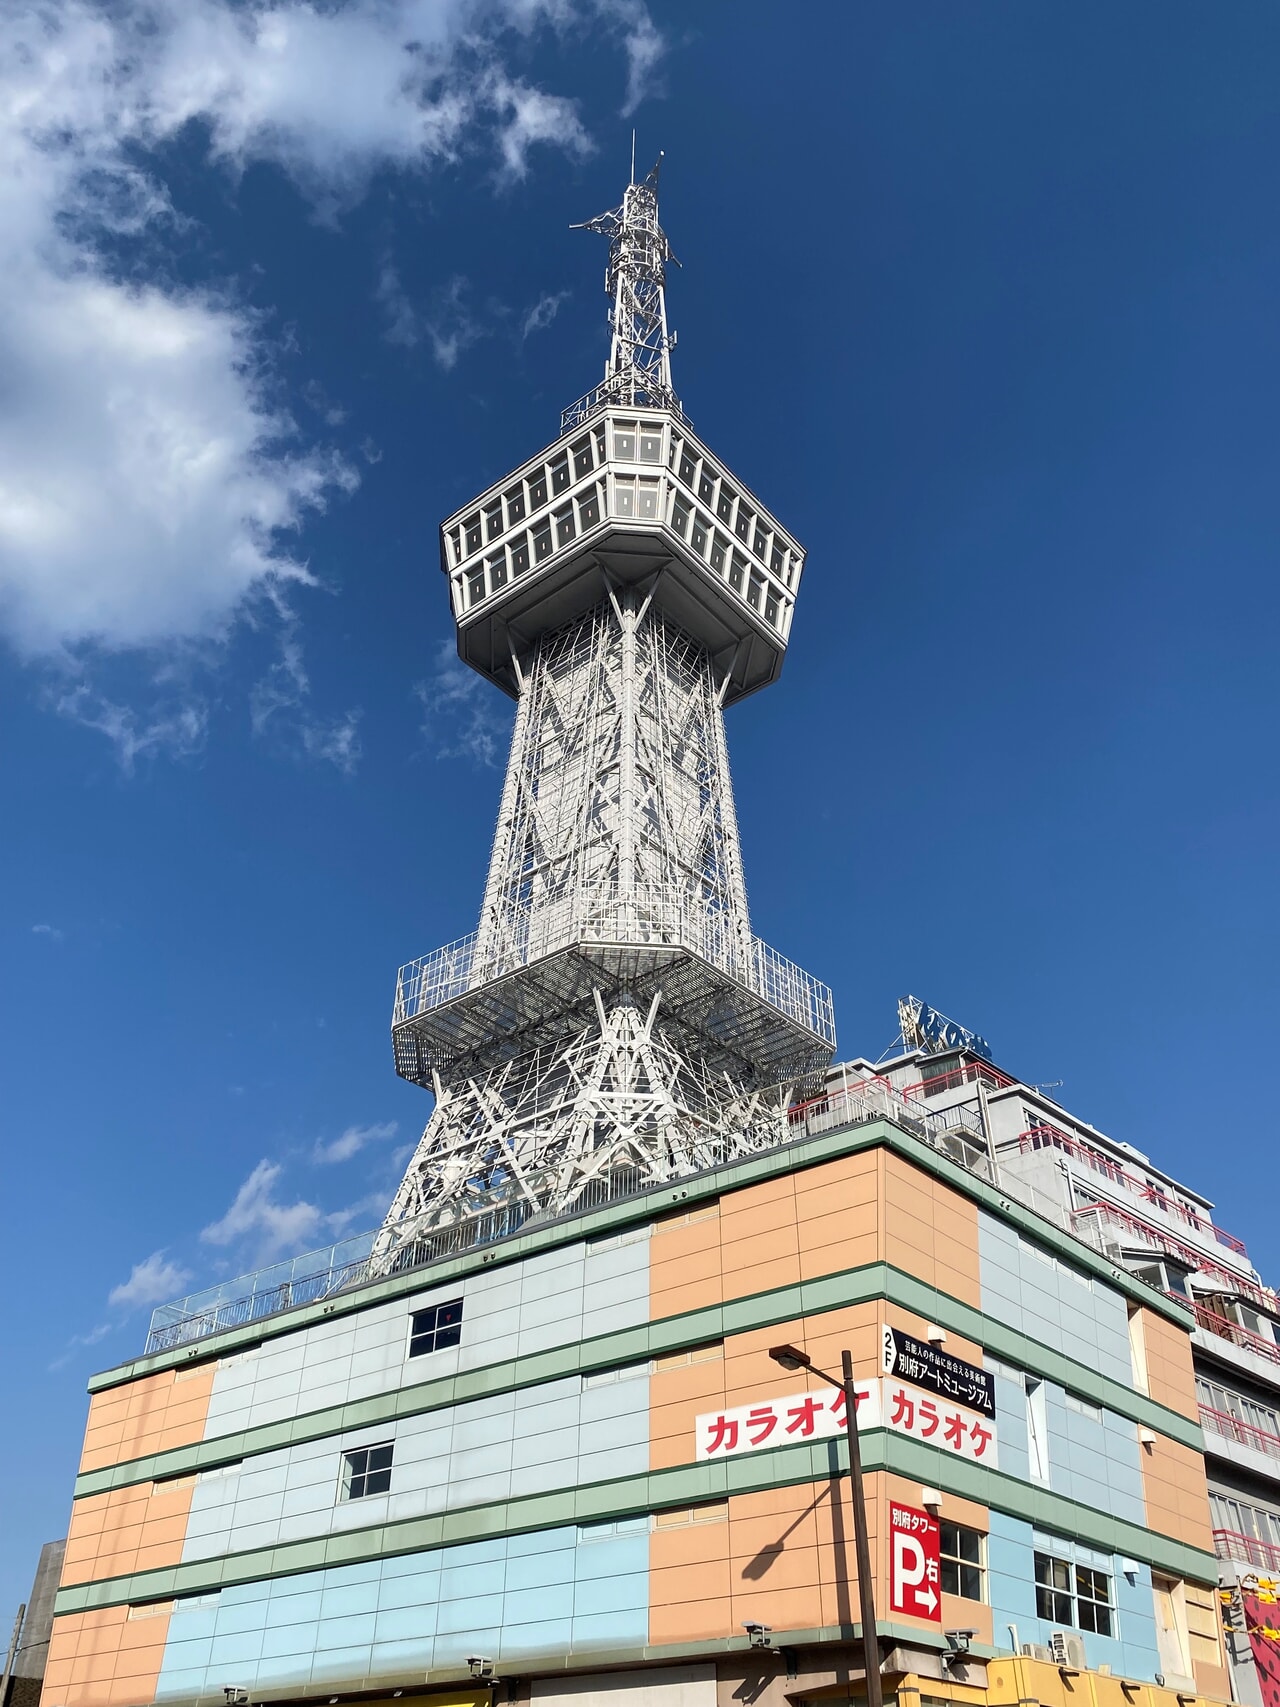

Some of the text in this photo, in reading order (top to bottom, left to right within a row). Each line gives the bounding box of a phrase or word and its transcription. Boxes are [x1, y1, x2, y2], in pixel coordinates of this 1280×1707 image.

[884, 1332, 892, 1367] 2F
[904, 1339, 987, 1387] 芸能人の作品に出会える美術館
[898, 1352, 993, 1410] 別府アートミュージアム
[705, 1389, 870, 1454] カラオケ
[890, 1388, 993, 1458] カラオケ
[892, 1507, 938, 1534] 別府タワー
[893, 1530, 939, 1609] P 右
